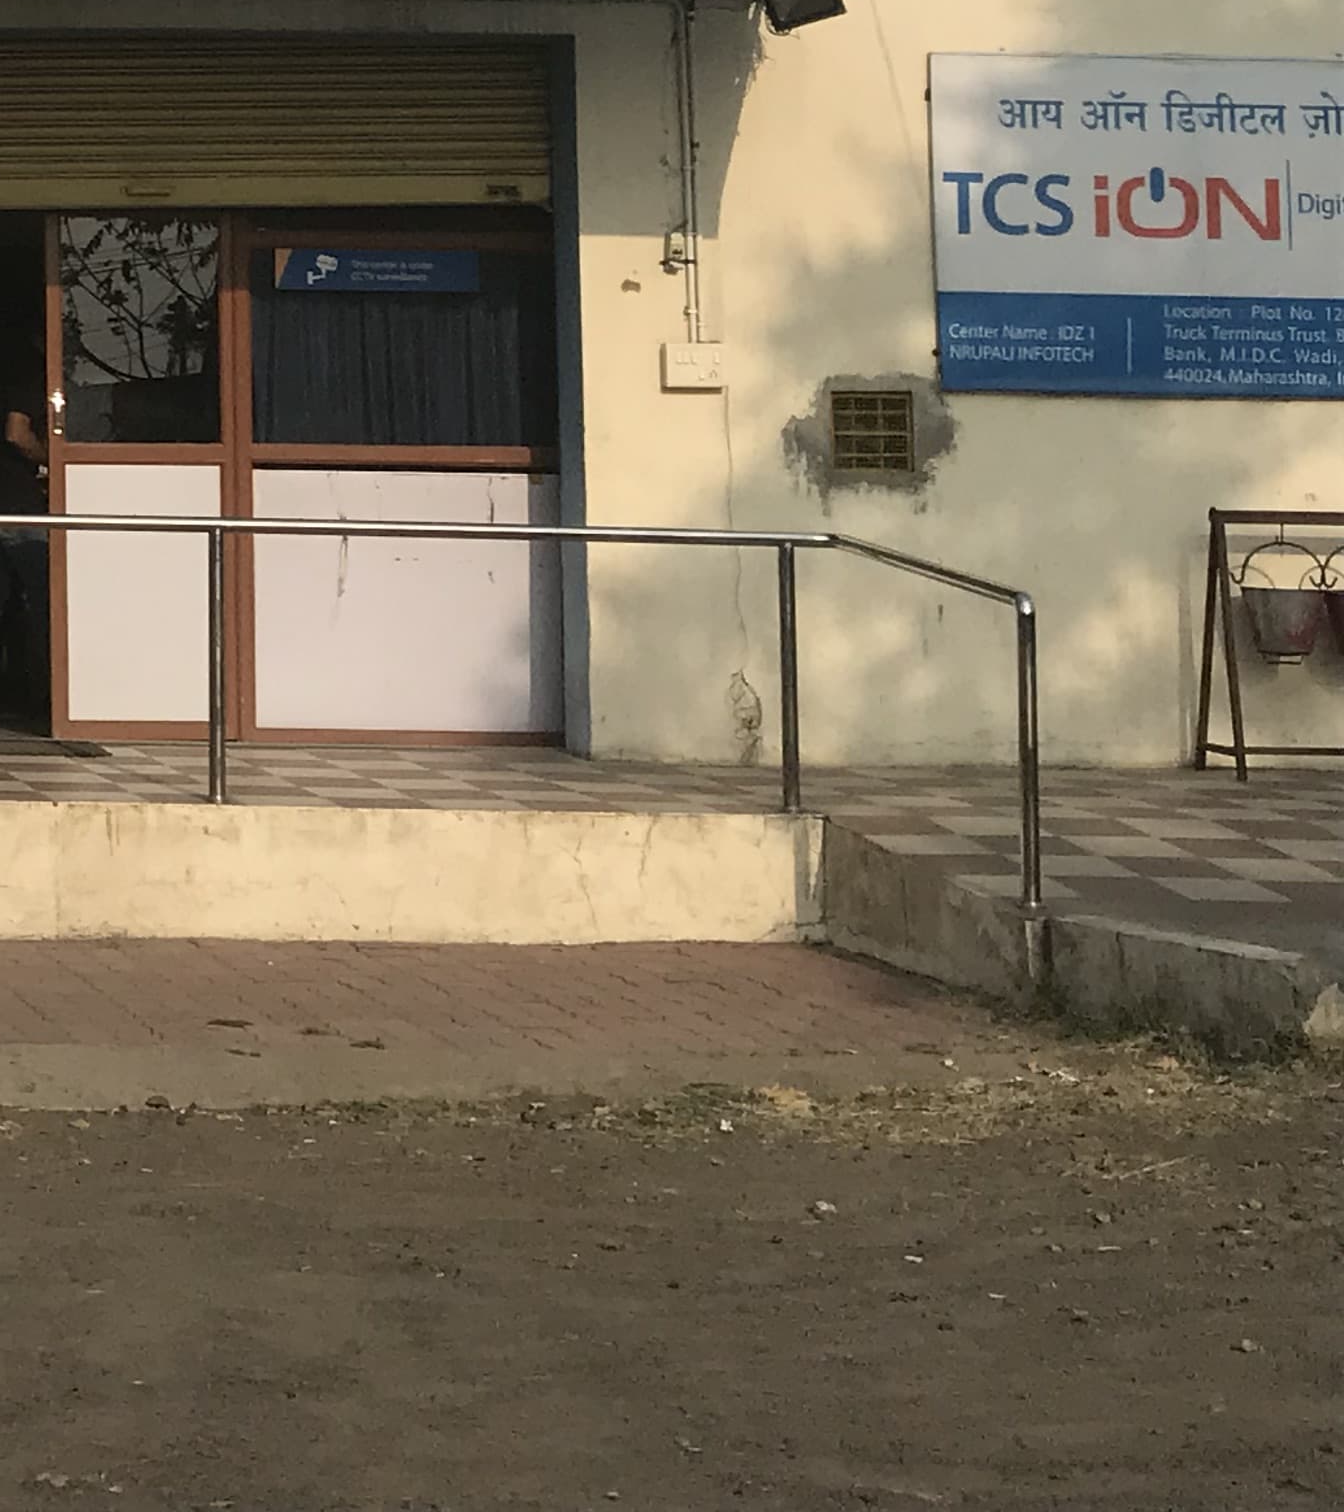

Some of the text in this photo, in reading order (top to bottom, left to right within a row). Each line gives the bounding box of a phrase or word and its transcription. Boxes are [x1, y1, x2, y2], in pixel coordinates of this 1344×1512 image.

[997, 98, 1064, 131] आय
[1080, 90, 1148, 132] ऑन
[1161, 89, 1286, 136] डिजीटल
[942, 171, 1075, 236] TCS
[1163, 303, 1233, 320] Location
[1251, 304, 1282, 320] Plot
[1289, 305, 1316, 321] No.
[948, 322, 1000, 339] Center
[1002, 324, 1048, 341] Name
[1057, 326, 1086, 341] IDZ
[1163, 324, 1208, 341] Truck
[1211, 325, 1284, 342] Terminus
[949, 344, 1095, 363] NRUPALI INFOTECH
[1164, 345, 1212, 363] Bank,
